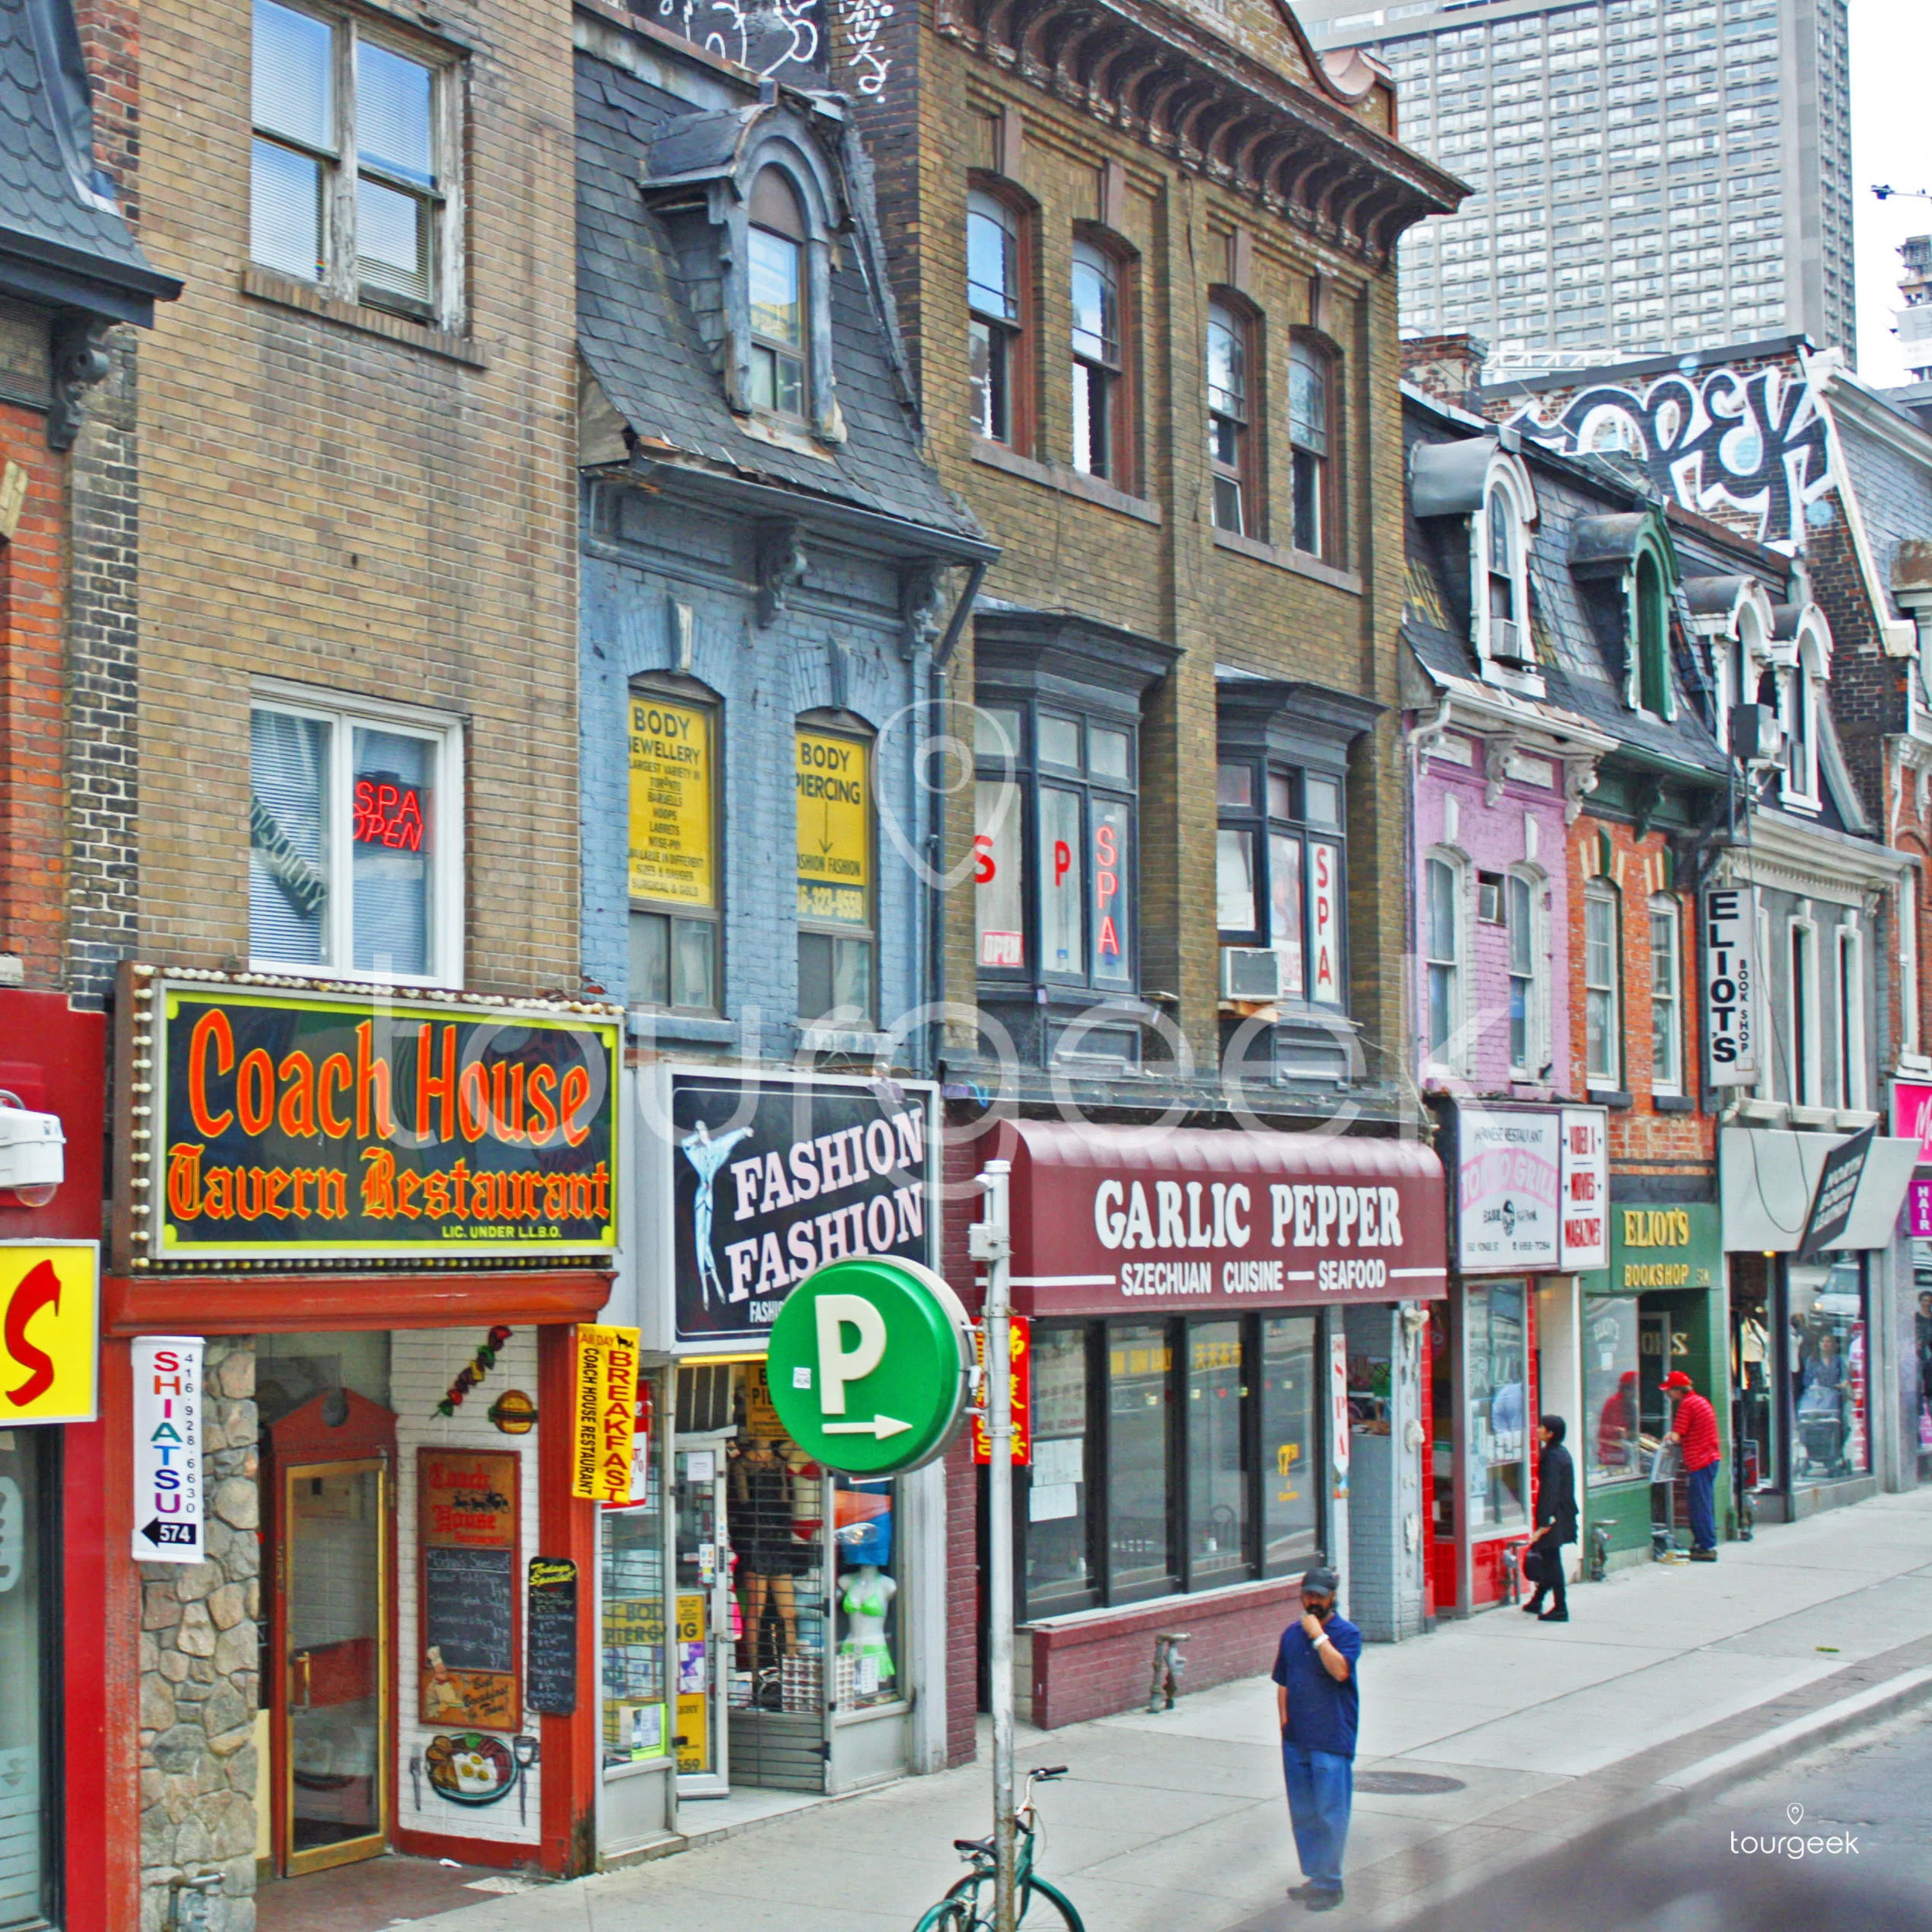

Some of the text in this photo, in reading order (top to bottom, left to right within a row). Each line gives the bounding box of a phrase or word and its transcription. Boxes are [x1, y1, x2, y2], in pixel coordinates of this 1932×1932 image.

[633, 706, 691, 740] BODY
[801, 742, 850, 772] BODY
[354, 780, 422, 825] SPA
[828, 858, 861, 876] FASHION
[1054, 839, 1070, 887] P
[1096, 825, 1120, 955] SPA
[1316, 846, 1332, 986] SPA
[985, 934, 1021, 963] OPEN
[1708, 892, 1740, 1063] ELIOT'S
[1738, 958, 1750, 1053] BOOK SHOP
[189, 1008, 591, 1147] Coach House
[168, 1143, 611, 1221] Tavern Restaurant
[730, 1107, 923, 1222] FASHION
[1570, 1172, 1595, 1202] MOVIES
[1094, 1179, 1403, 1250] GARLIC PEPPER
[1624, 1206, 1691, 1247] ELIOT'S
[1918, 1185, 1931, 1231] HAIR
[441, 1225, 467, 1238] LIC.
[469, 1226, 515, 1239] UNDER
[724, 1182, 923, 1303] FASHION
[1564, 1217, 1601, 1249] MAGAZINES
[1121, 1259, 1386, 1296] SZECHUAN CUISINE SEAFOOD
[1624, 1264, 1690, 1287] BOOKSHOP
[815, 1294, 887, 1414] P
[150, 1351, 183, 1514] SHIATSU
[579, 1347, 599, 1495] COACH HOUSE RESTAURANT
[603, 1350, 633, 1502] BREAKFAST
[429, 1462, 491, 1490] Coach
[159, 1524, 191, 1543] 574
[431, 1504, 497, 1533] House
